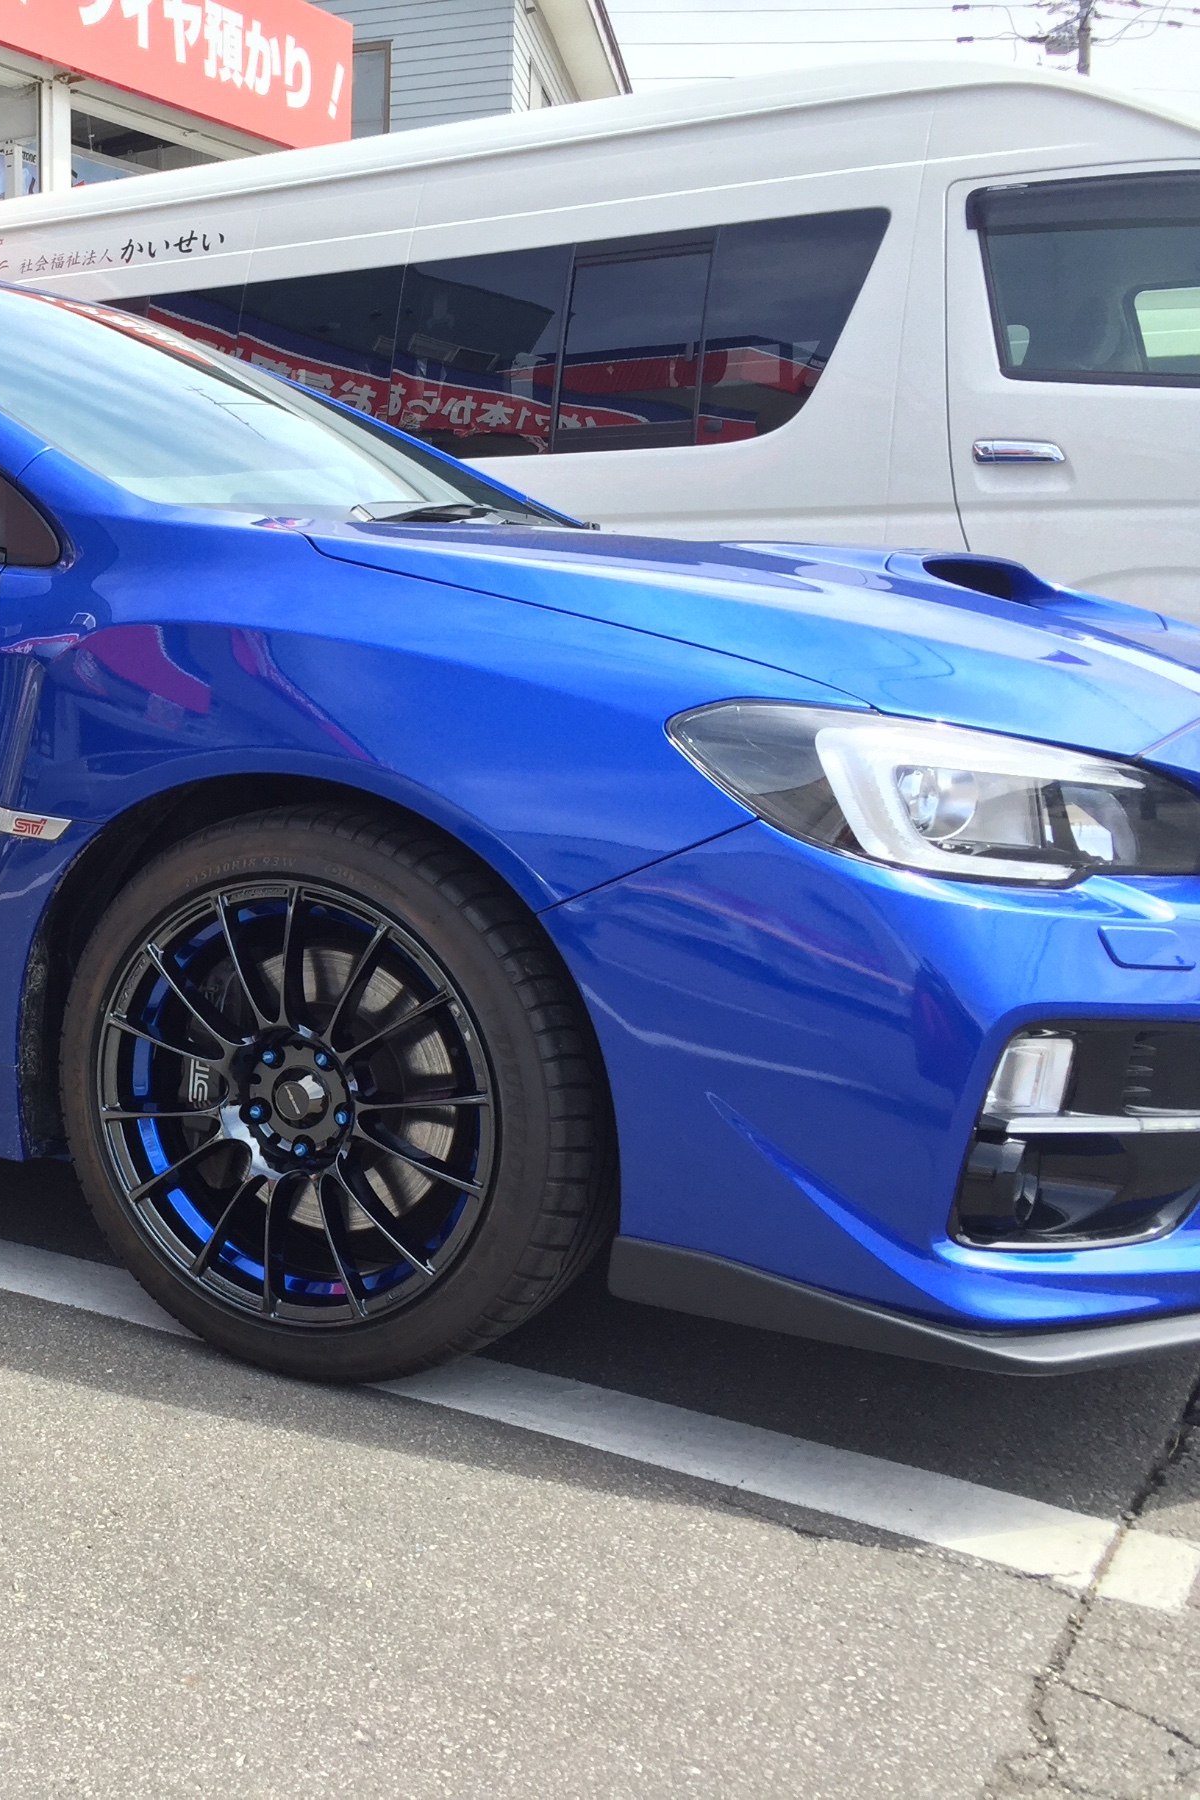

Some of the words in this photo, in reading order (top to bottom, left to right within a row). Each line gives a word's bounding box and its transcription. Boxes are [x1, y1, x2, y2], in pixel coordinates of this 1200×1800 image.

[19, 248, 113, 274] 社会福祉法人
[120, 230, 225, 264] かいせい
